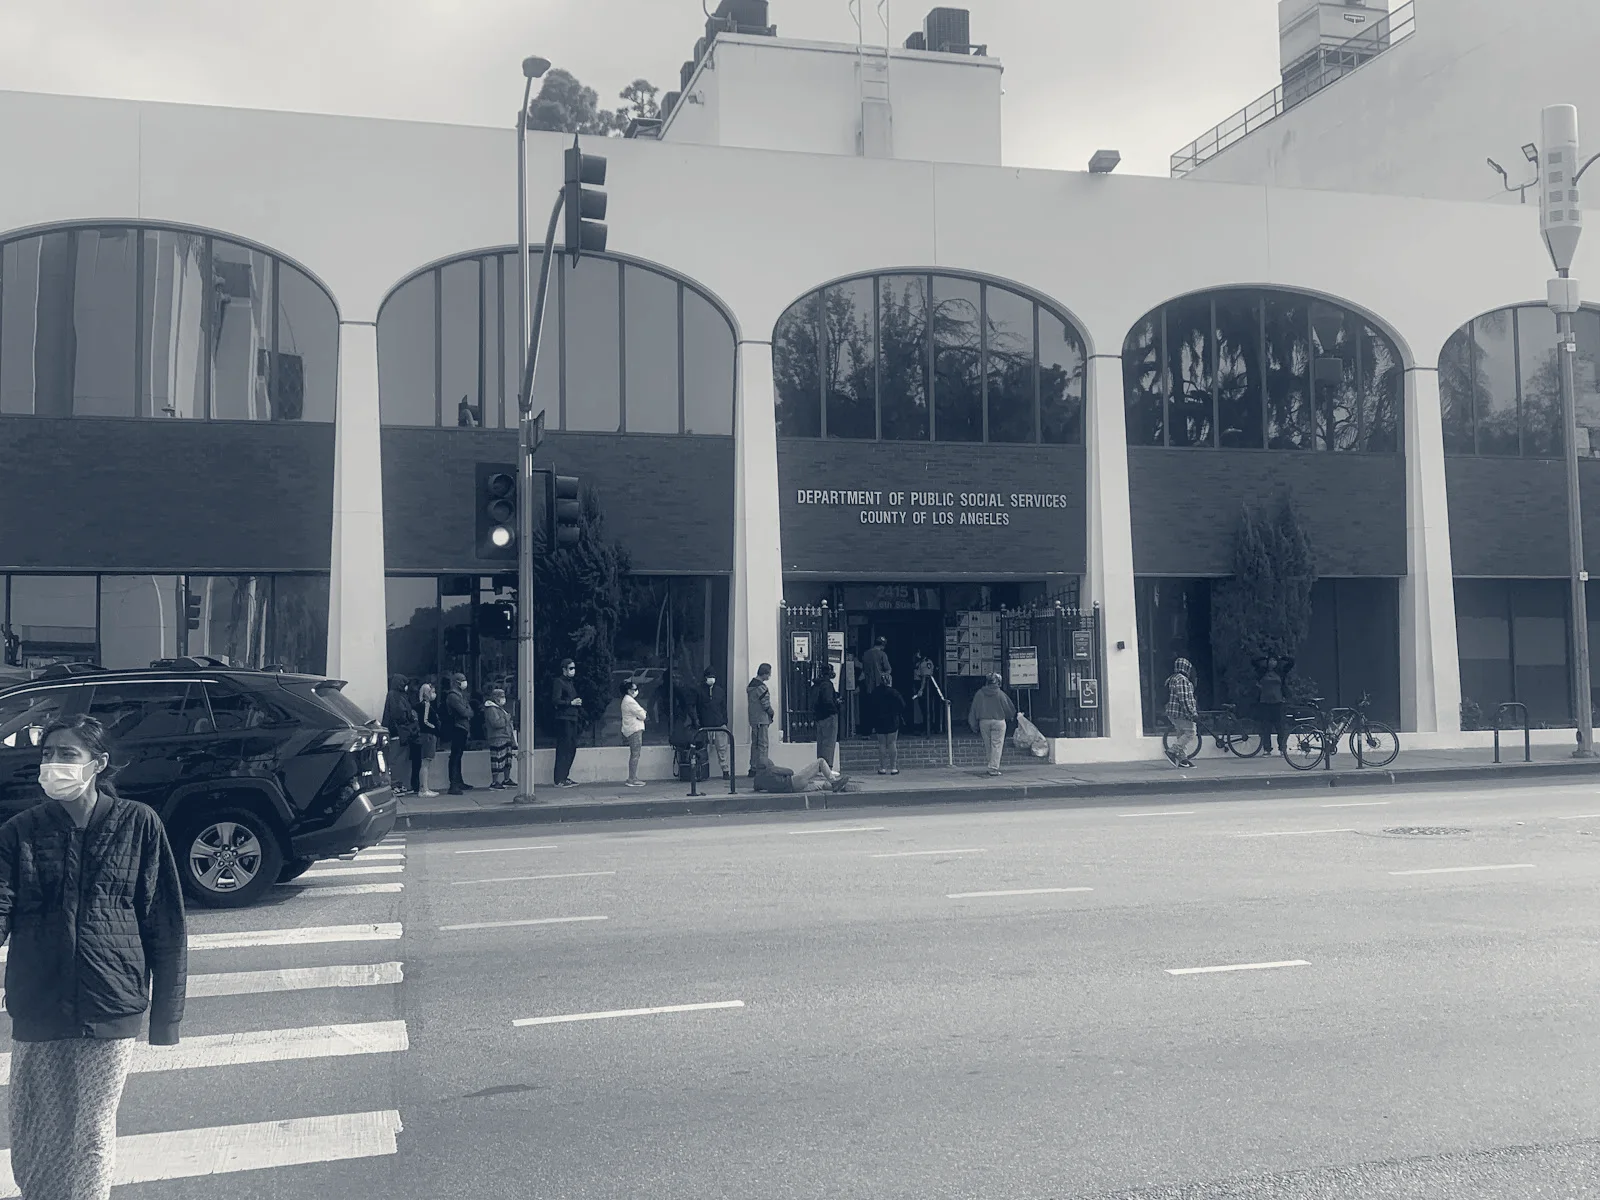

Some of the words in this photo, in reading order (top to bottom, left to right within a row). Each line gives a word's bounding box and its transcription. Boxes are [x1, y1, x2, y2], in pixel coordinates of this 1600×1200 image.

[797, 489, 882, 505] DEPARTMENT
[888, 492, 905, 506] OF
[910, 492, 954, 507] PUBLIC
[959, 493, 1005, 508] SOCIAL
[1010, 493, 1067, 509] SERVICES
[860, 510, 907, 524] COUNTY
[912, 511, 927, 525] OF
[932, 511, 954, 525] LOS
[959, 512, 1010, 526] ANGELES
[876, 585, 909, 598] 2415
